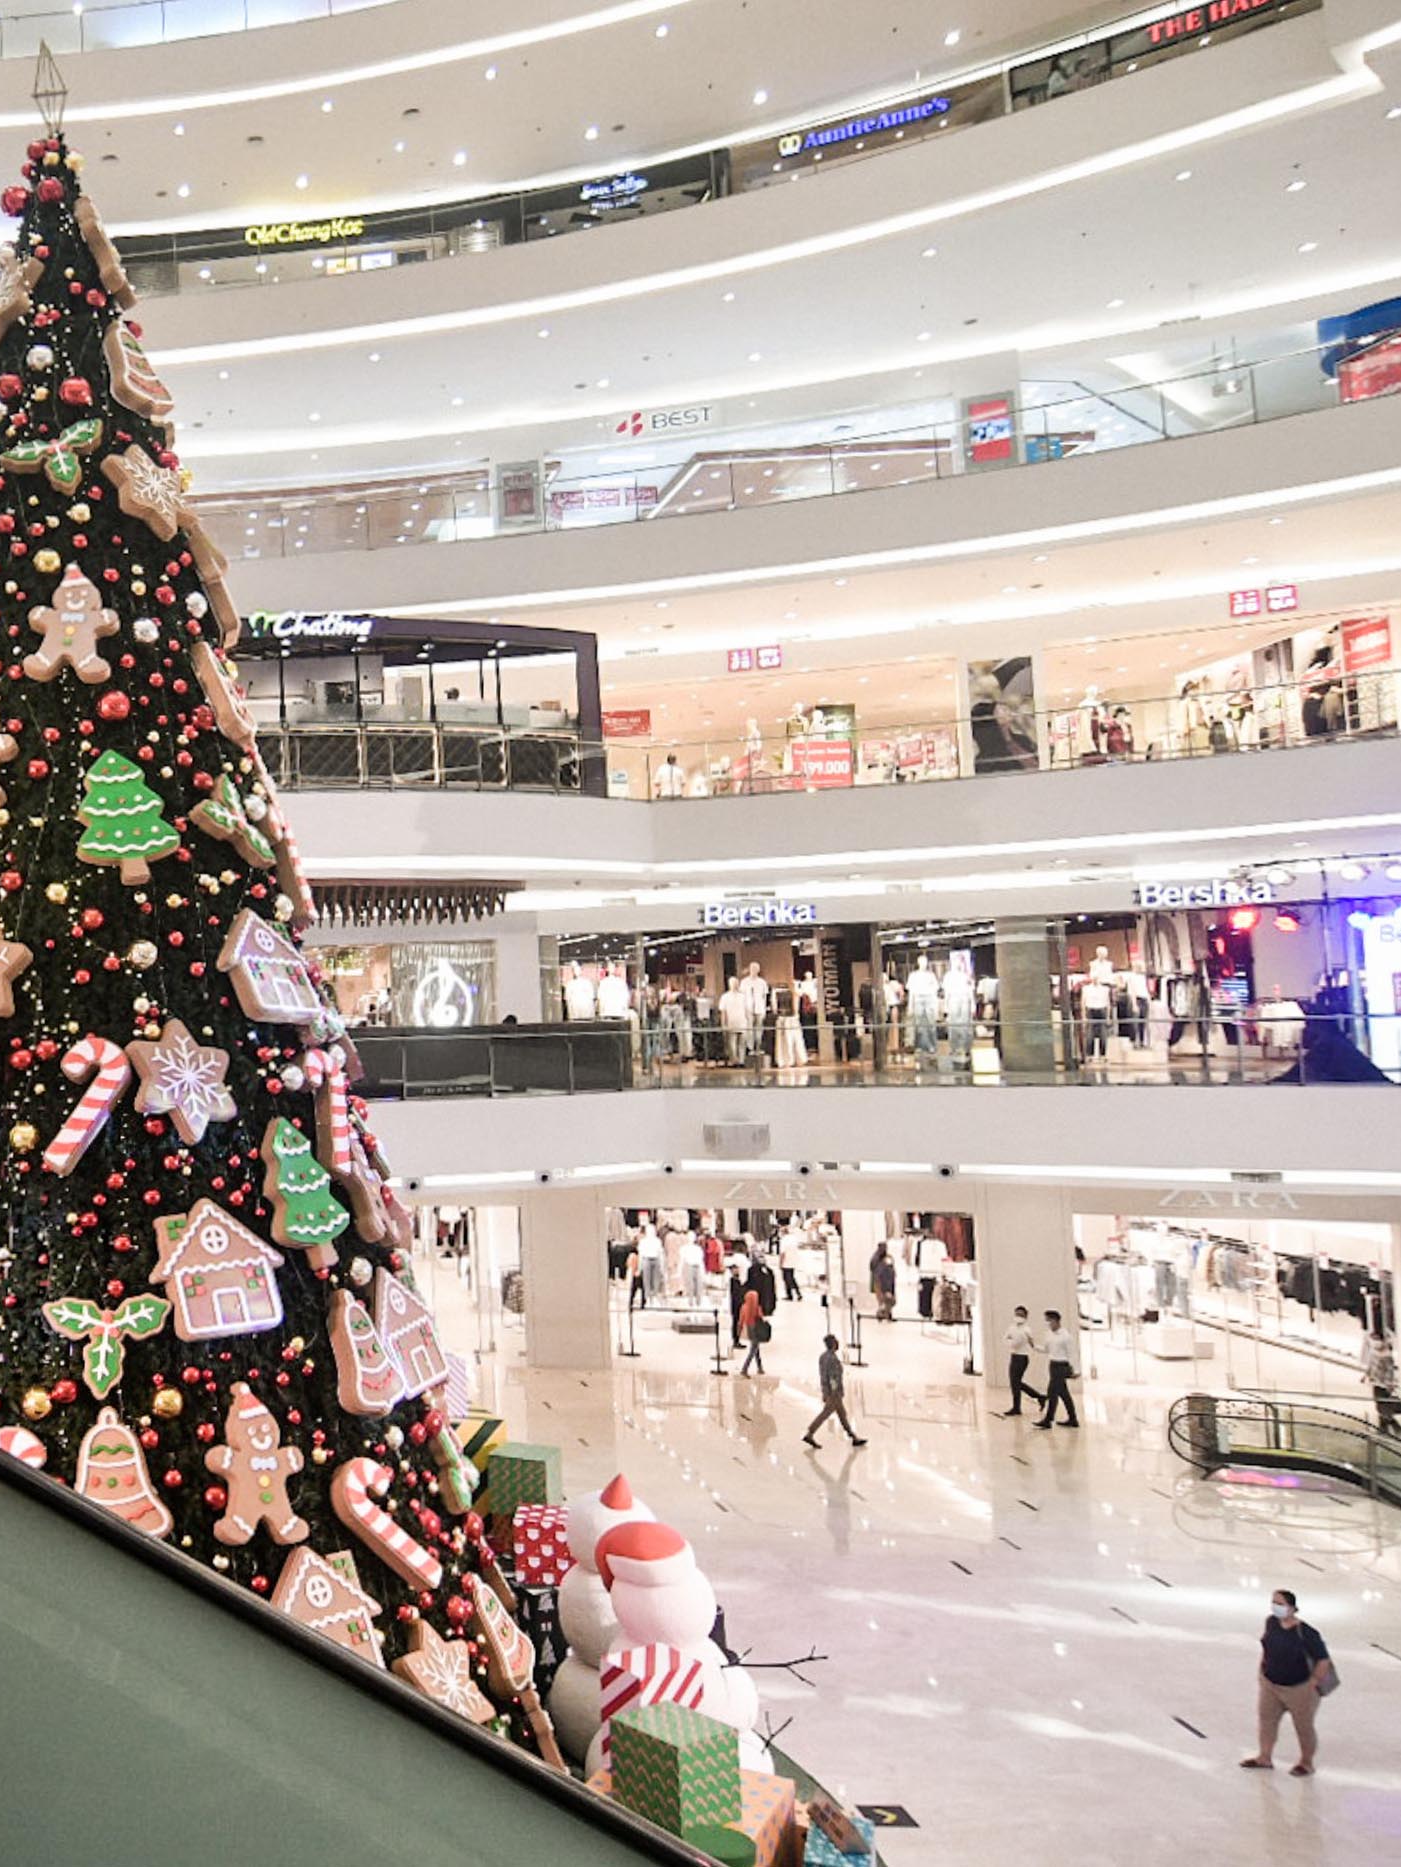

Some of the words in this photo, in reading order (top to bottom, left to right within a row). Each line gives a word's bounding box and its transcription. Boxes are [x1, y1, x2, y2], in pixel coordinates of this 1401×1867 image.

[1146, 10, 1203, 44] THE
[651, 406, 713, 430] BEST
[273, 611, 373, 638] Chatime
[1140, 879, 1273, 908] Bershka
[703, 900, 813, 927] Bershka
[723, 1181, 840, 1201] ZARA
[1156, 1187, 1302, 1210] ZARA
